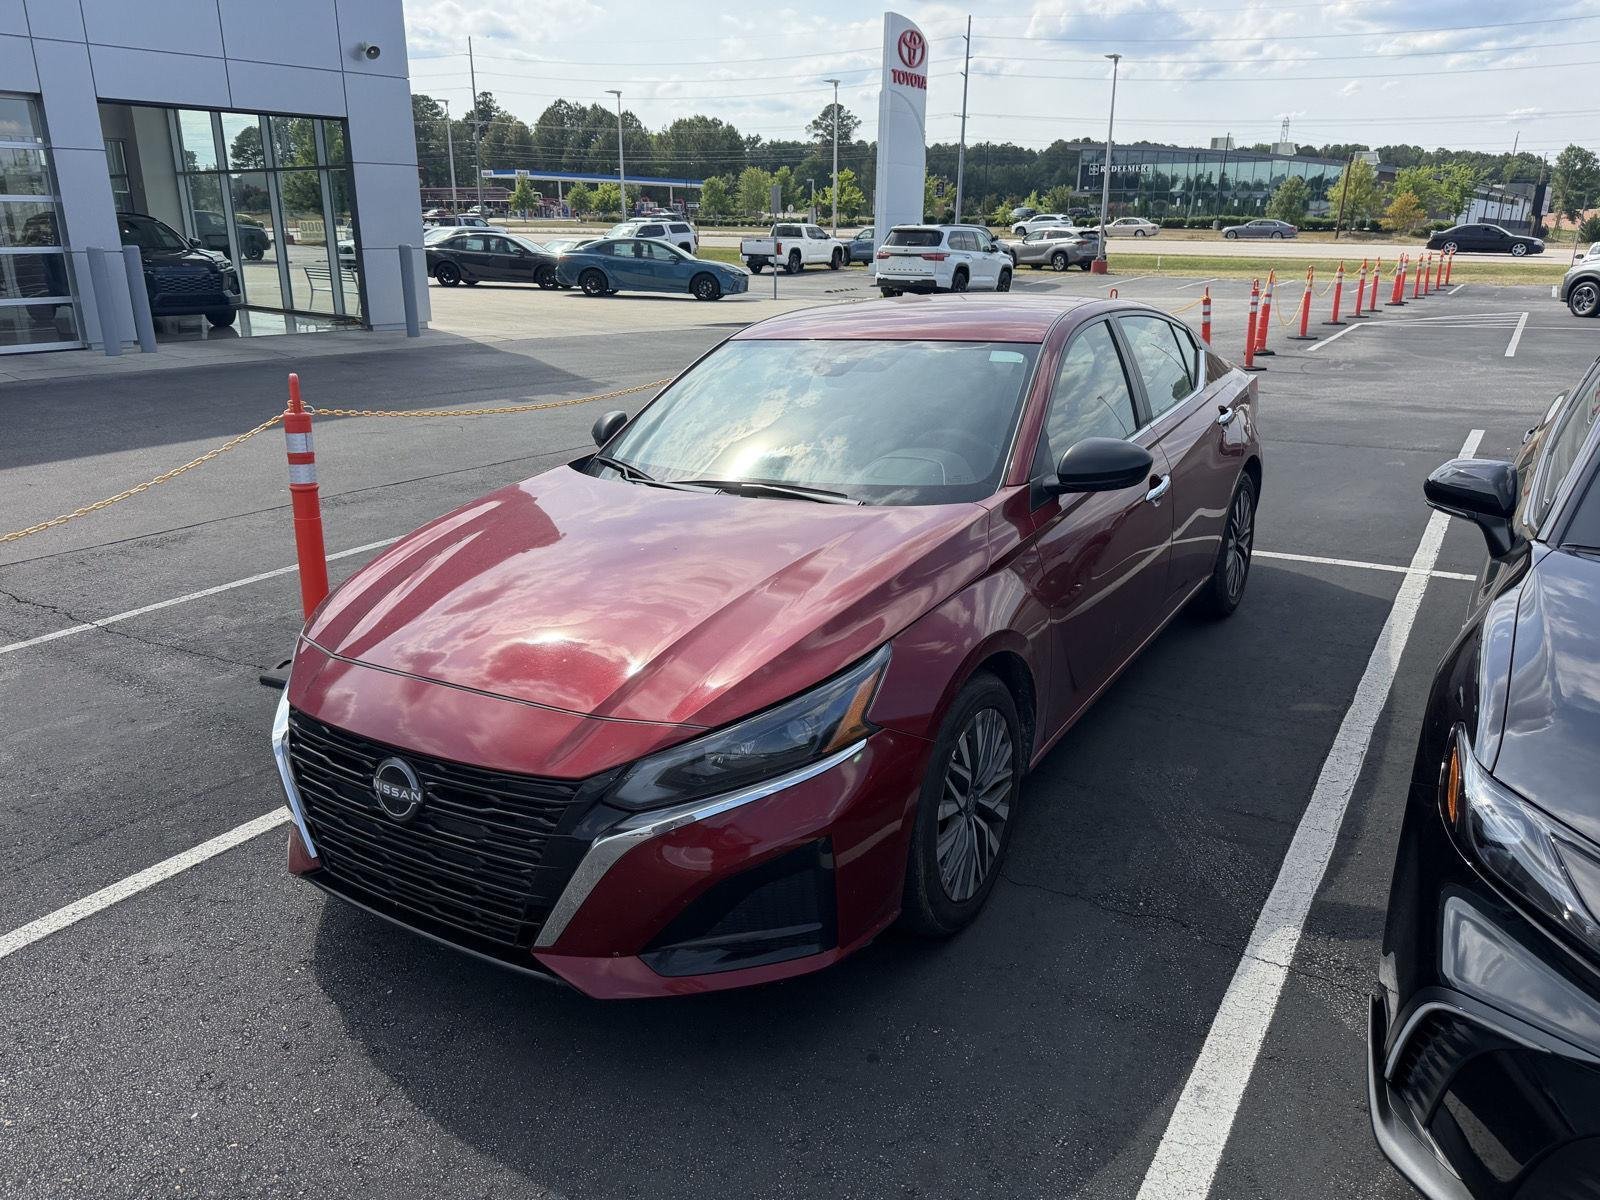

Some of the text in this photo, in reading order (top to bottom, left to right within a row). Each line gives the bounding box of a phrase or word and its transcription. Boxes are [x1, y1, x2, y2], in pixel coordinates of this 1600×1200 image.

[891, 69, 927, 90] TOYOTA
[1100, 164, 1148, 173] RDEEMER
[373, 778, 421, 802] NISSAN
